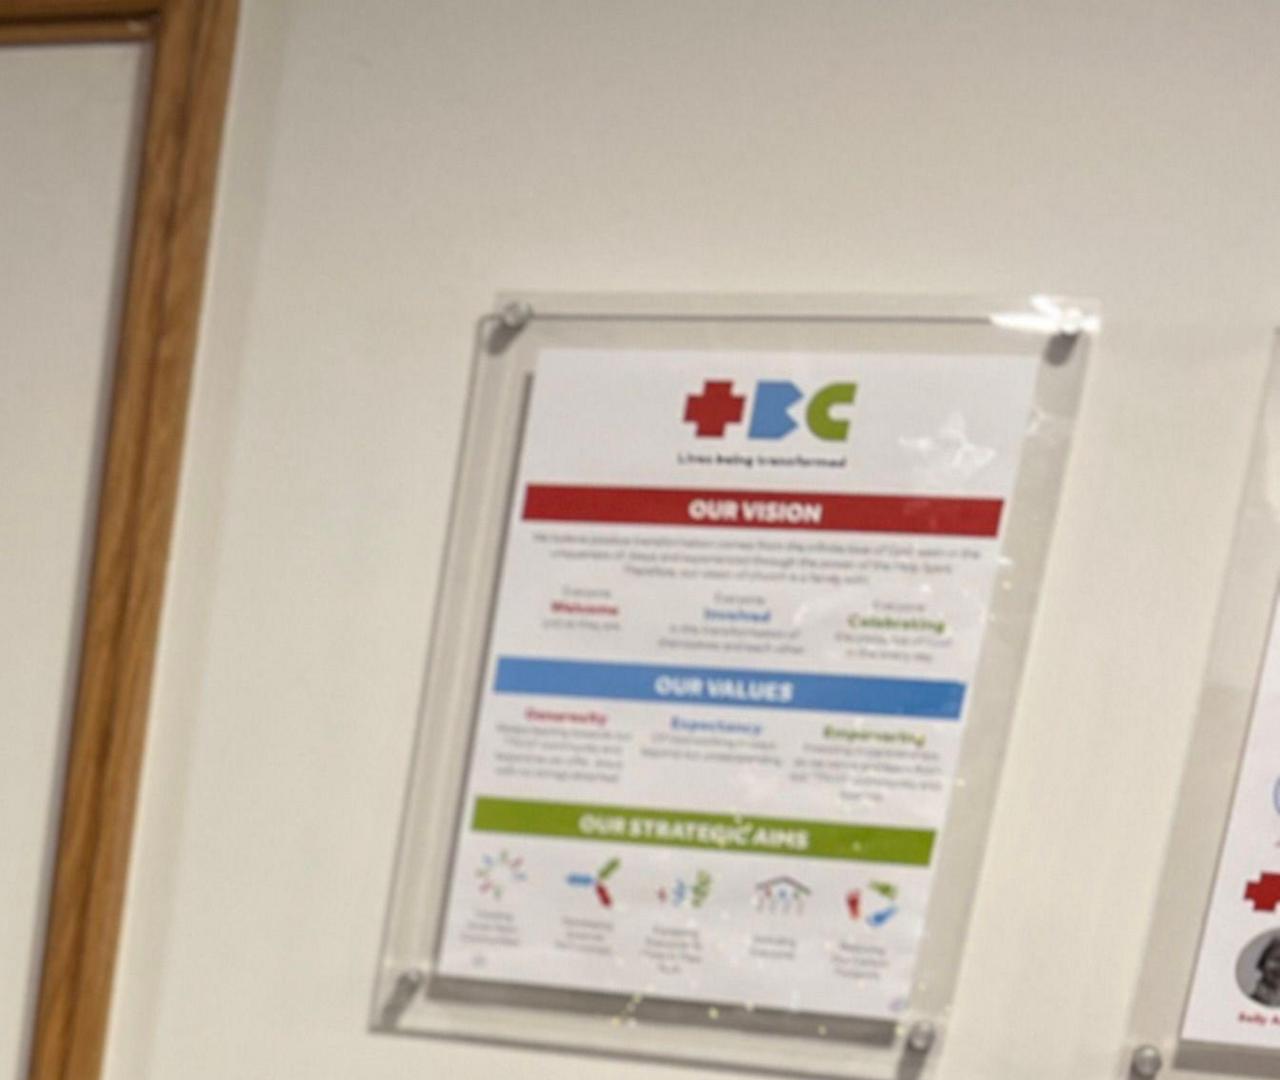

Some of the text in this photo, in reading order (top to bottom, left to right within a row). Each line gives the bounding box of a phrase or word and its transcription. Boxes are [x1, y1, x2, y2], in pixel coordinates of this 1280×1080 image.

[689, 501, 823, 525] OUR VISION
[550, 600, 620, 615] Welcome
[703, 608, 771, 623] Involved
[847, 613, 946, 636] Celebrating
[654, 675, 794, 703] OUR VALUES
[579, 813, 810, 851] OUR STRATEGIC AIMS
